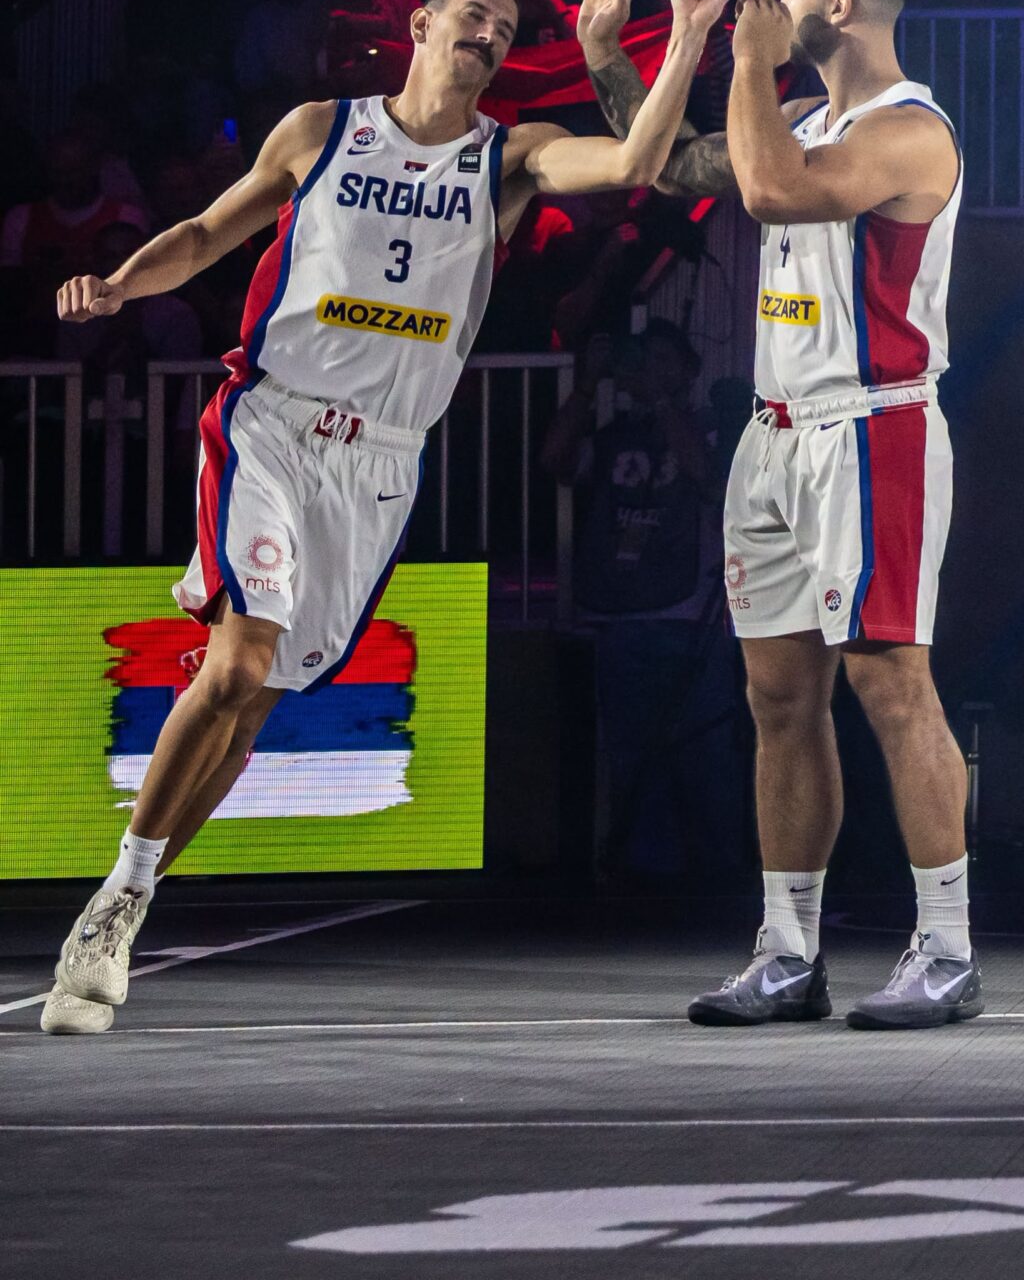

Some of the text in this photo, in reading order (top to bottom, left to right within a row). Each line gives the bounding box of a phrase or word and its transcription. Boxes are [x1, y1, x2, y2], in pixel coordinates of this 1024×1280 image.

[336, 172, 472, 224] SRBIJA
[384, 239, 413, 283] 3
[323, 299, 447, 338] MOZZART
[245, 577, 281, 593] mts
[729, 596, 751, 610] mts
